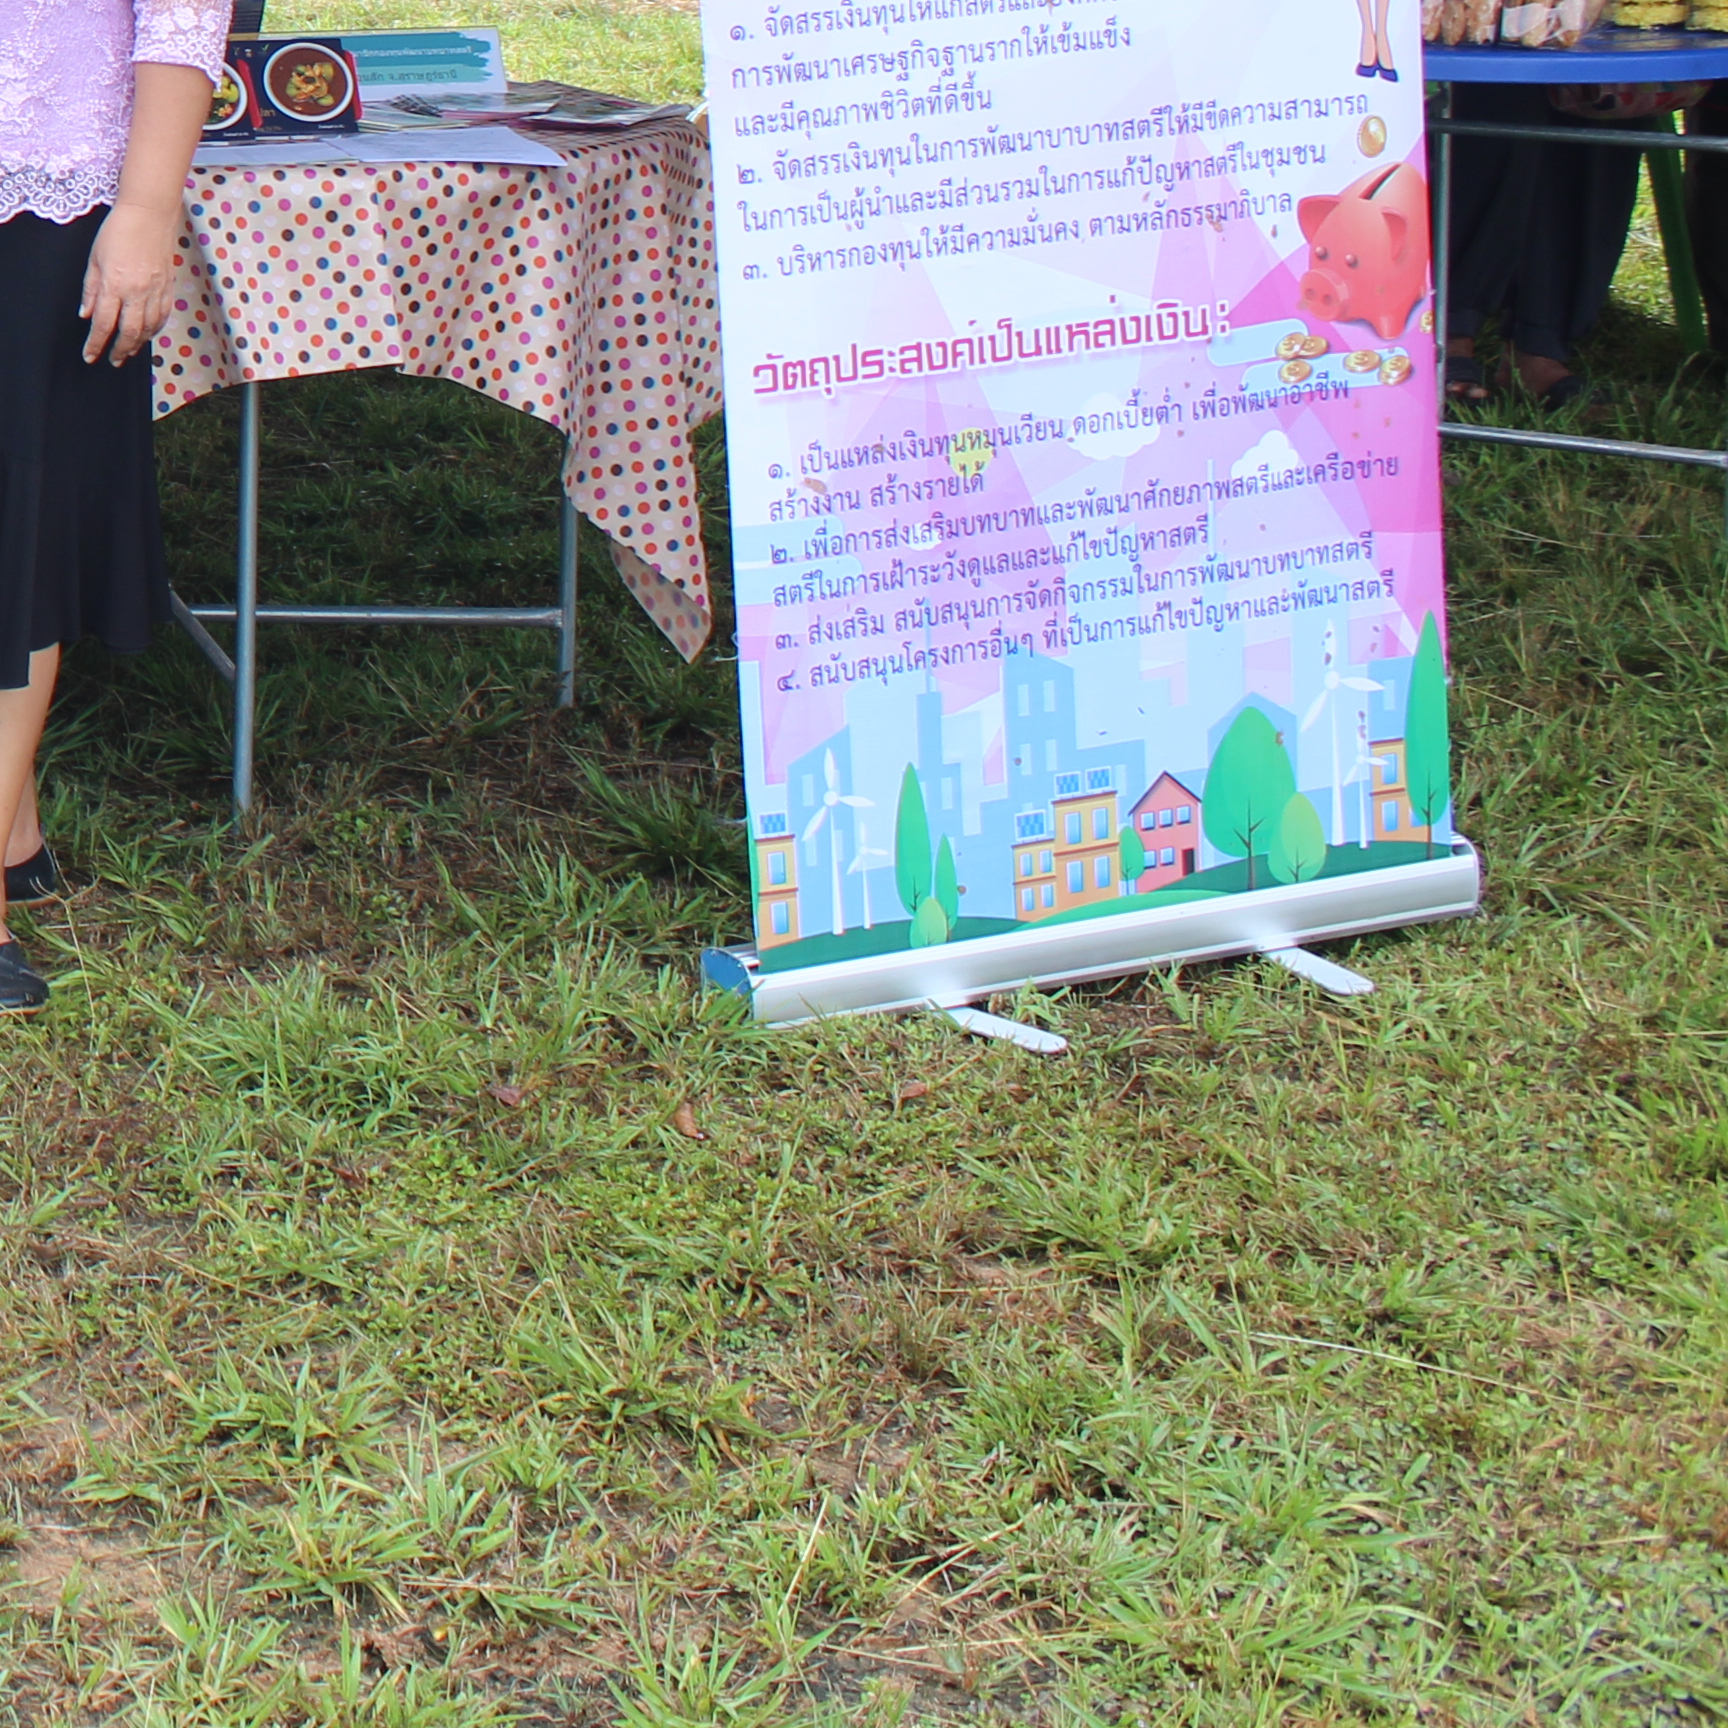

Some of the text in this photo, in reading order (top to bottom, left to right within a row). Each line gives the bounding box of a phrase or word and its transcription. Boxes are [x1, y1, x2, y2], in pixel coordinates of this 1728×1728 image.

[732, 14, 1132, 89] การพัฒนาเศรษฐกิจฐานรากให้เข้มแข็ง
[776, 206, 1080, 276] บริหารกองทุนให้มีความมั่นคง
[1089, 189, 1293, 238] ตามหลักธรรมาภิบาล
[800, 412, 1063, 474] เป็นแหล่งเงินทุนหมุนเวียน
[1074, 386, 1183, 435] ดอกเบี้ยต่ำ
[1192, 372, 1350, 421] เพื่อพัฒนาอาชีพ
[769, 460, 984, 522] สร้างงาน สร้างรายได้
[809, 619, 1034, 686] สนับสนุนโครงการอื่นๆ
